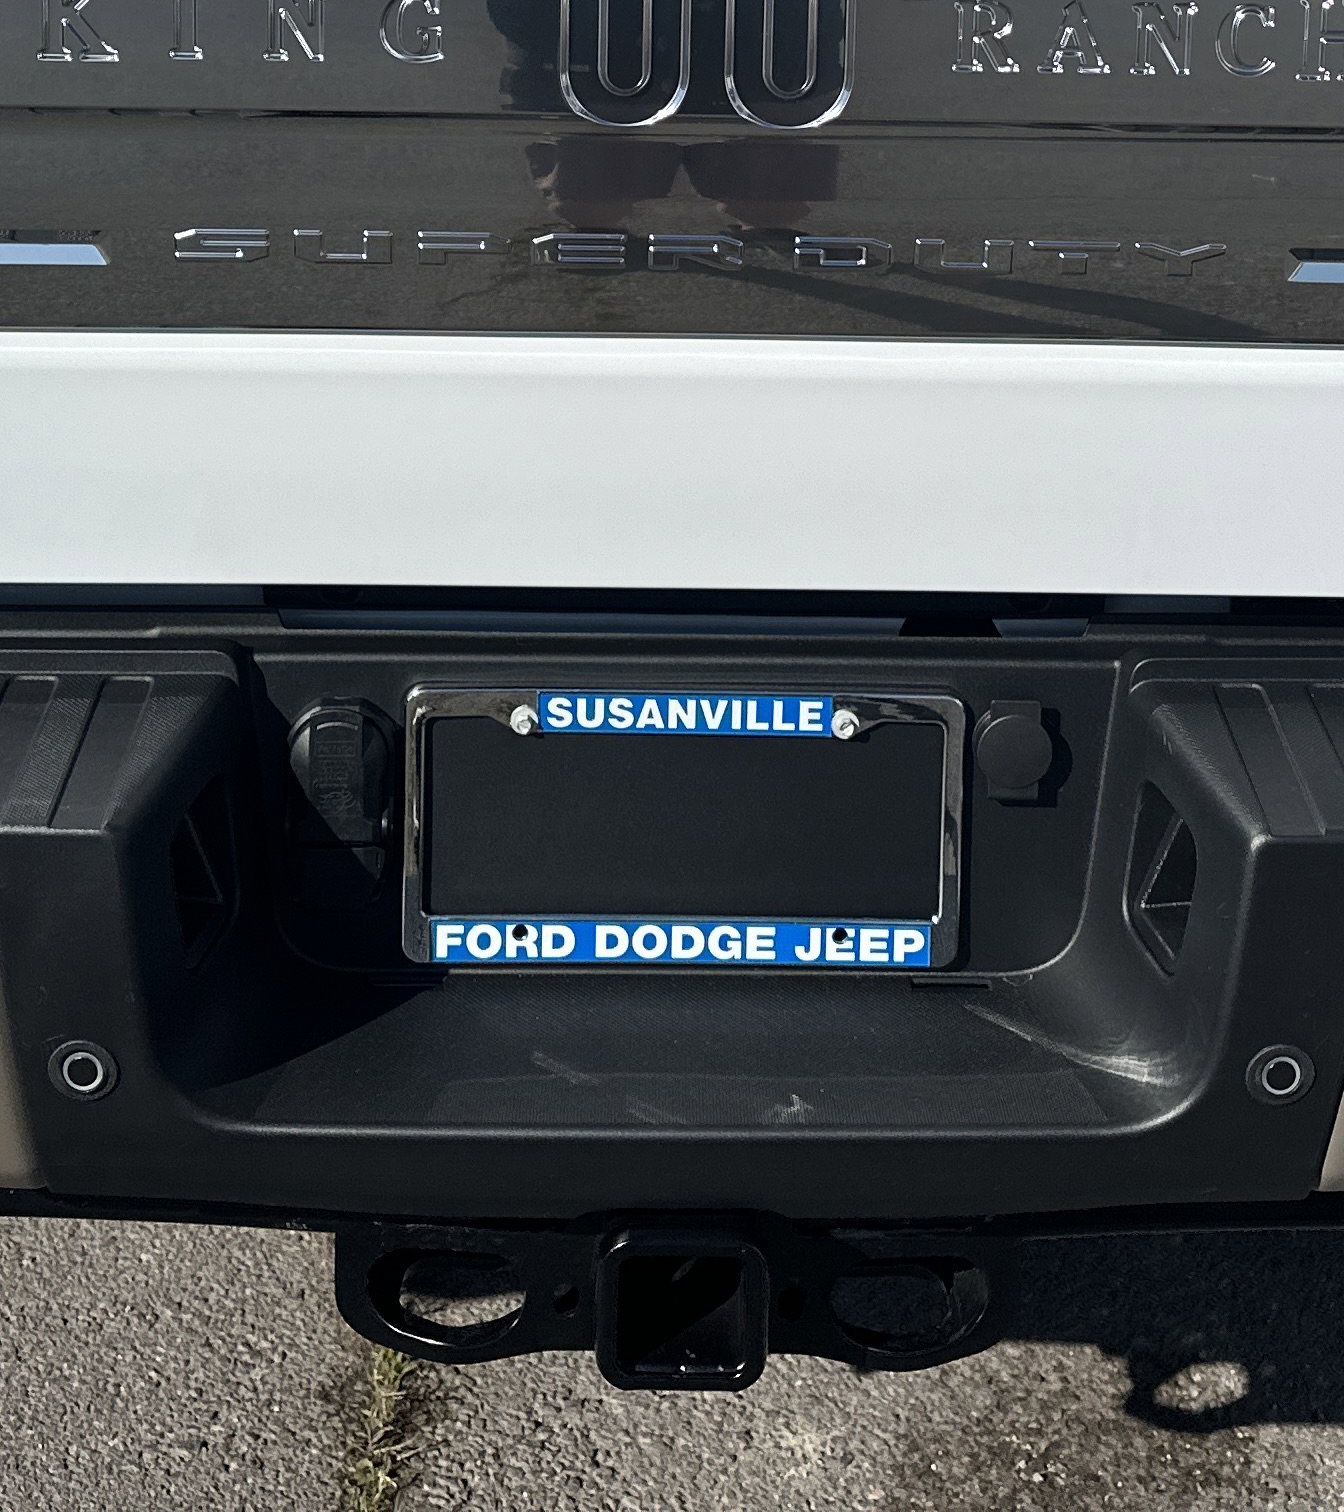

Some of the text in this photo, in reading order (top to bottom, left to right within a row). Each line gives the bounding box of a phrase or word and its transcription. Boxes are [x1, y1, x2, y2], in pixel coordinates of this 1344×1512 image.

[173, 228, 1227, 277] SUPER DUTY
[546, 696, 825, 732] SUSANVILLE
[435, 923, 926, 964] FORD DODGE JEEP
